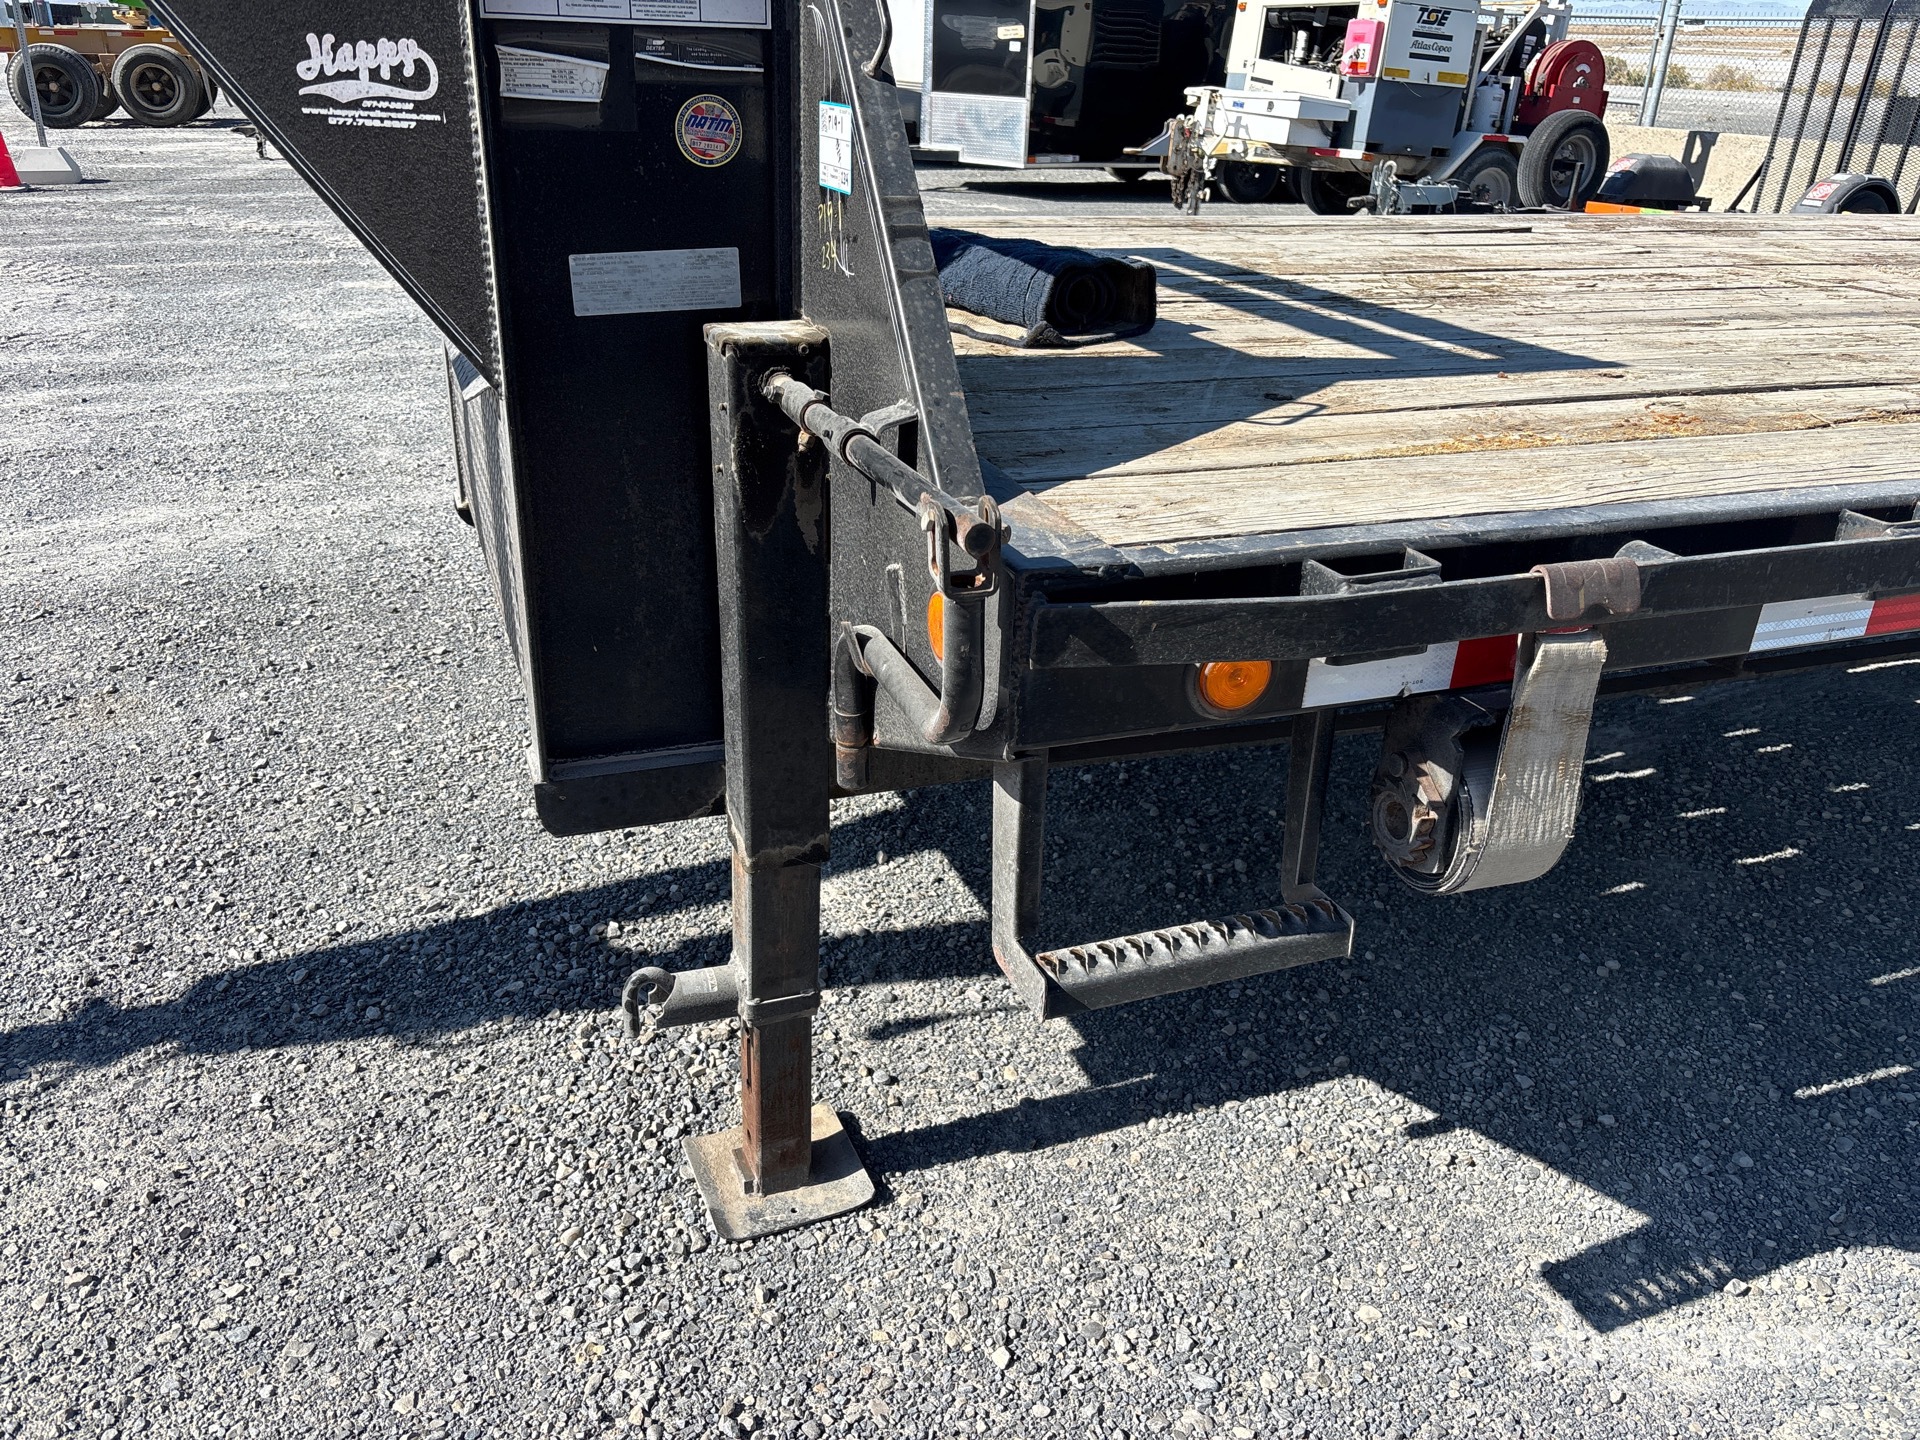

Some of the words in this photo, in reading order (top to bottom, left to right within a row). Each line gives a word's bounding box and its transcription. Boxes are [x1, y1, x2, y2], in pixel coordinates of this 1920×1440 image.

[1416, 7, 1452, 27] TSE
[1409, 39, 1431, 51] Atlas
[1431, 41, 1453, 54] Copco
[296, 32, 424, 84] Happy
